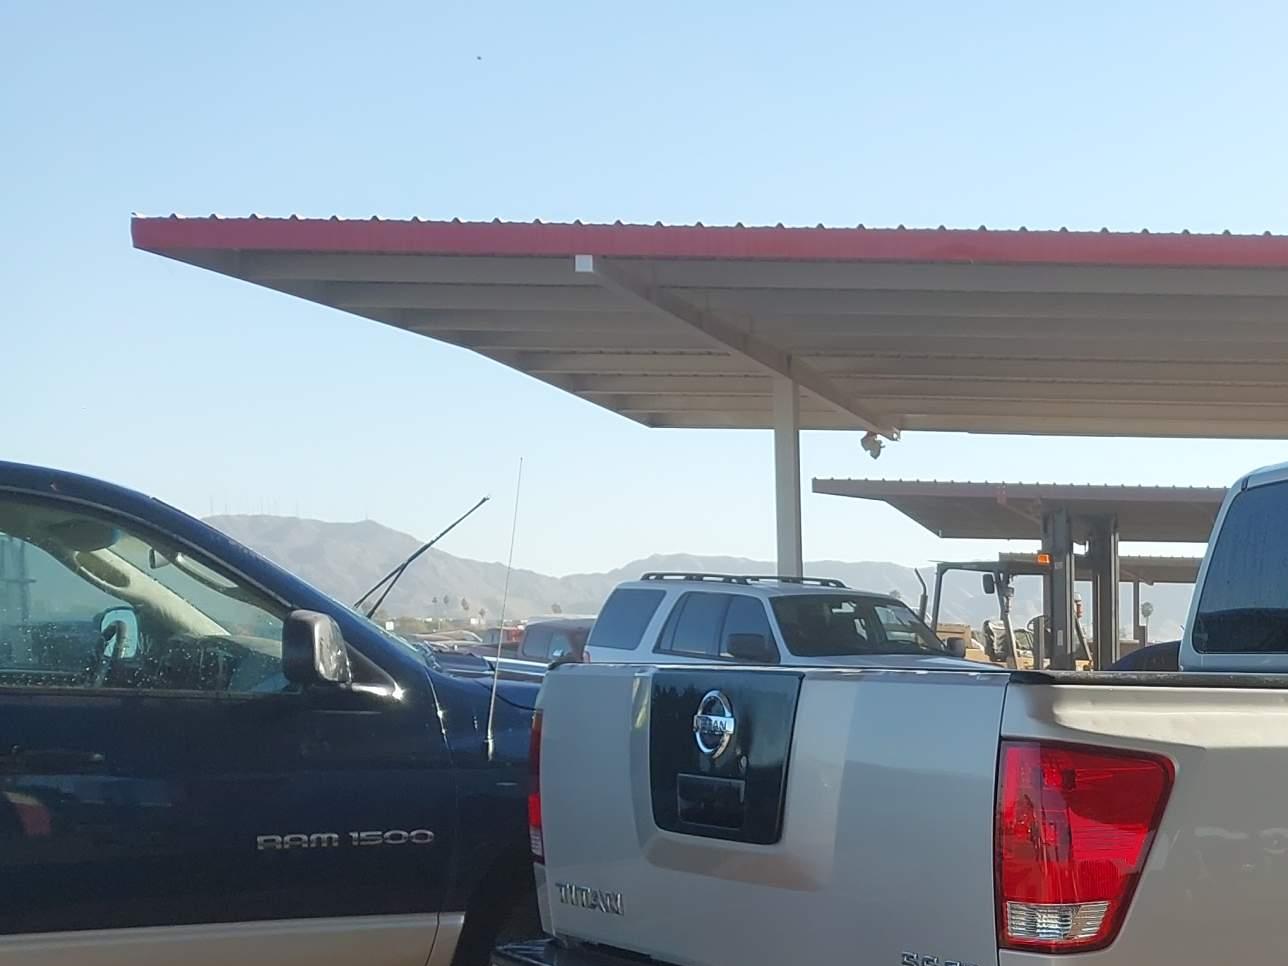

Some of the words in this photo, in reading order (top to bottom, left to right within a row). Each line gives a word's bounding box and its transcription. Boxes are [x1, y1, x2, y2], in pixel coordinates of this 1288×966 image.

[256, 832, 339, 850] RAM
[349, 829, 435, 846] 1500
[555, 882, 625, 916] TITAN
